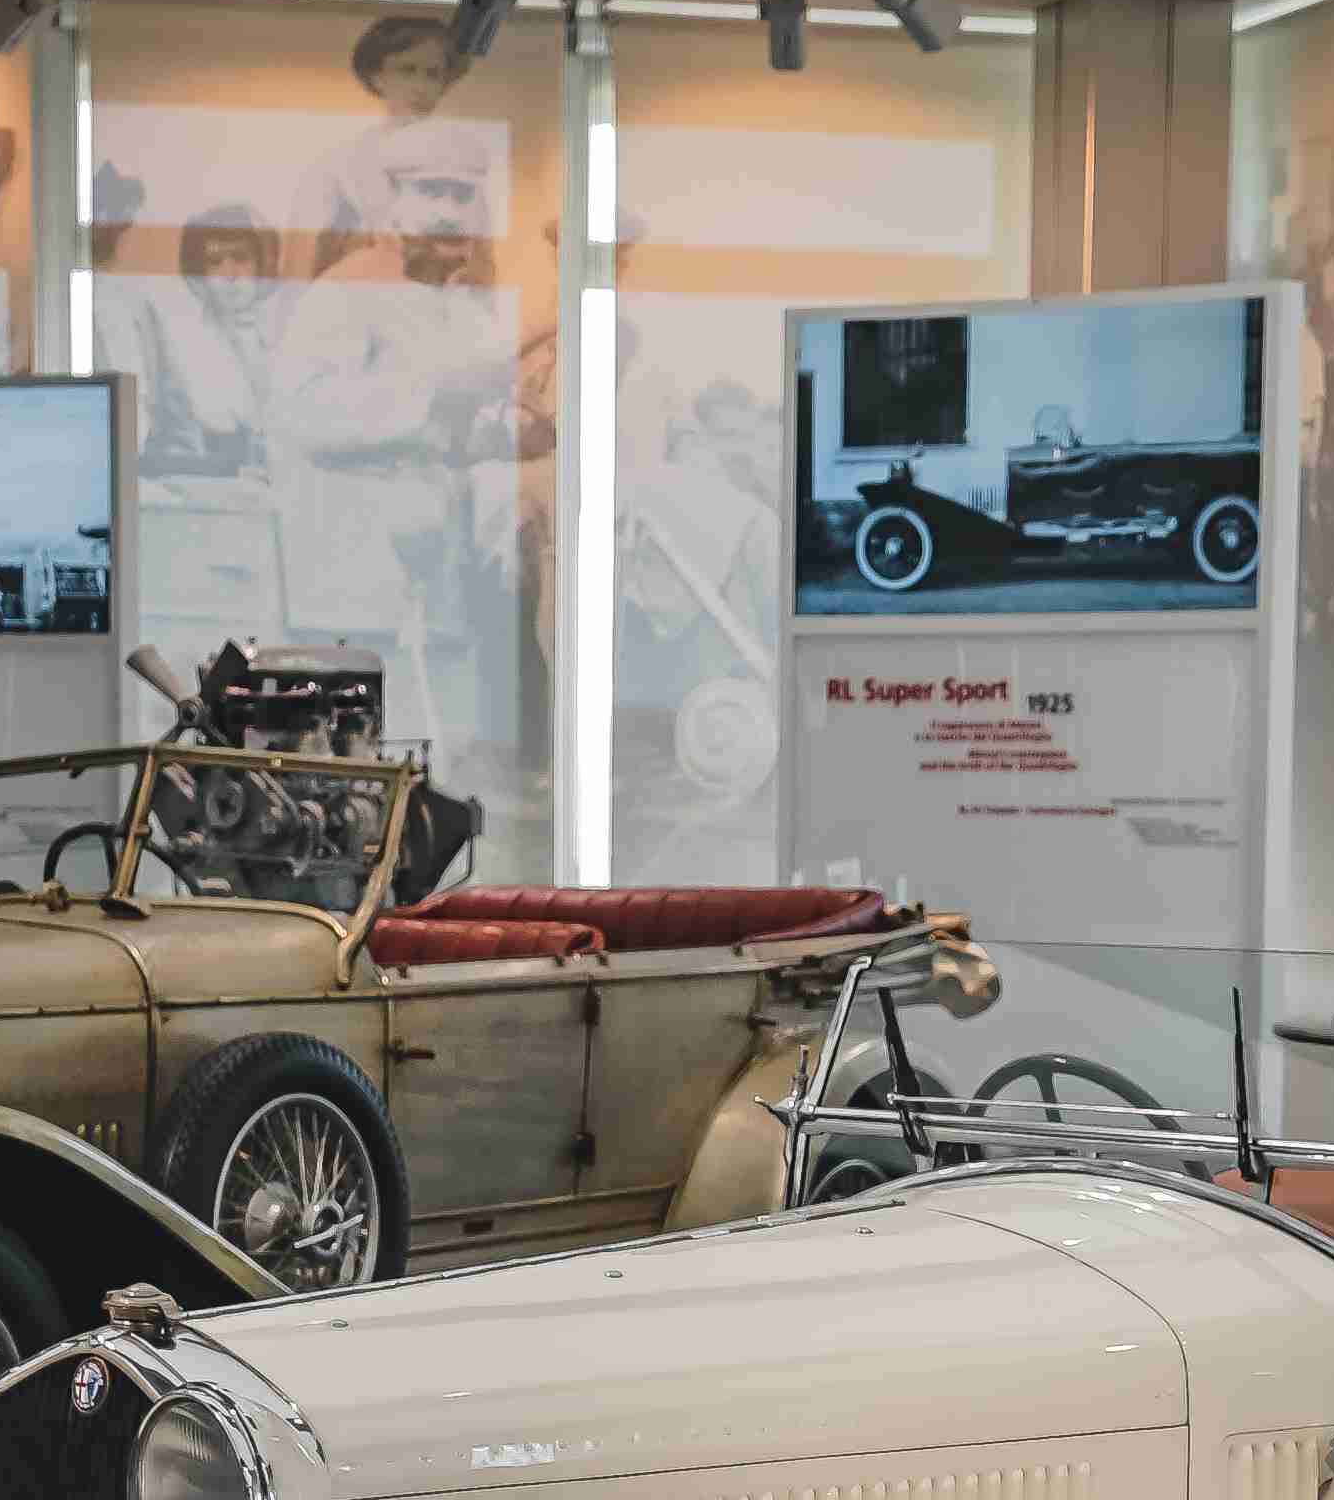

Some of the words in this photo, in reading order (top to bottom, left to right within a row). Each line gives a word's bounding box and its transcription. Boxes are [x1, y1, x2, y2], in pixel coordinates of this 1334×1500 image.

[827, 678, 854, 702] RL
[864, 677, 933, 706] Super
[942, 677, 1008, 706] Sport
[1027, 692, 1075, 714] 1925
